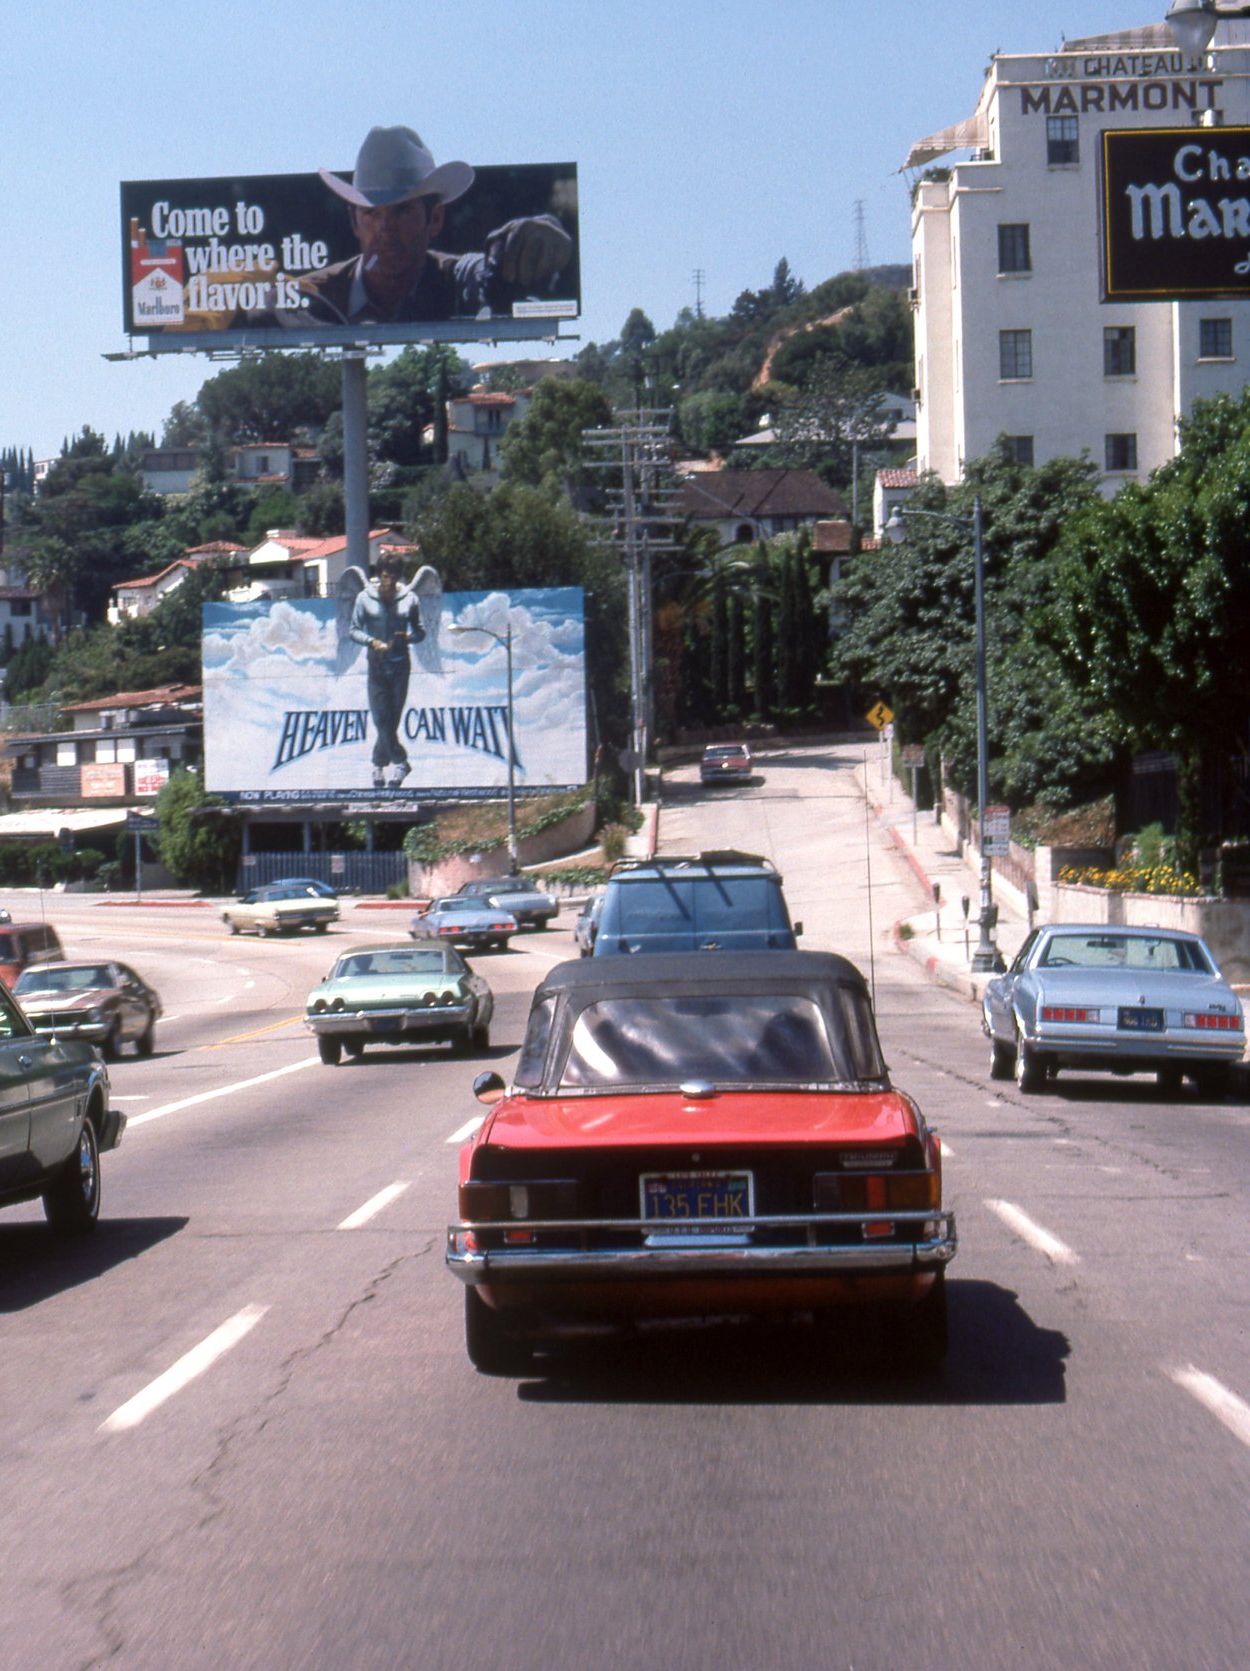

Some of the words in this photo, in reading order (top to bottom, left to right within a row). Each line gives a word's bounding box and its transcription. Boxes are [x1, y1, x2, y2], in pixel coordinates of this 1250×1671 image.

[1083, 53, 1183, 76] CHATEAU
[1021, 80, 1224, 115] MARMONT
[151, 201, 230, 238] Come
[235, 201, 265, 235] to
[185, 237, 275, 274] where
[281, 234, 328, 271] the
[138, 296, 180, 316] Marlboro
[187, 273, 272, 312] flavor
[276, 271, 310, 309] is.
[272, 709, 369, 770] HEAVEN
[404, 707, 446, 742] CAN
[449, 705, 525, 770] WAIT
[652, 1194, 690, 1219] 135
